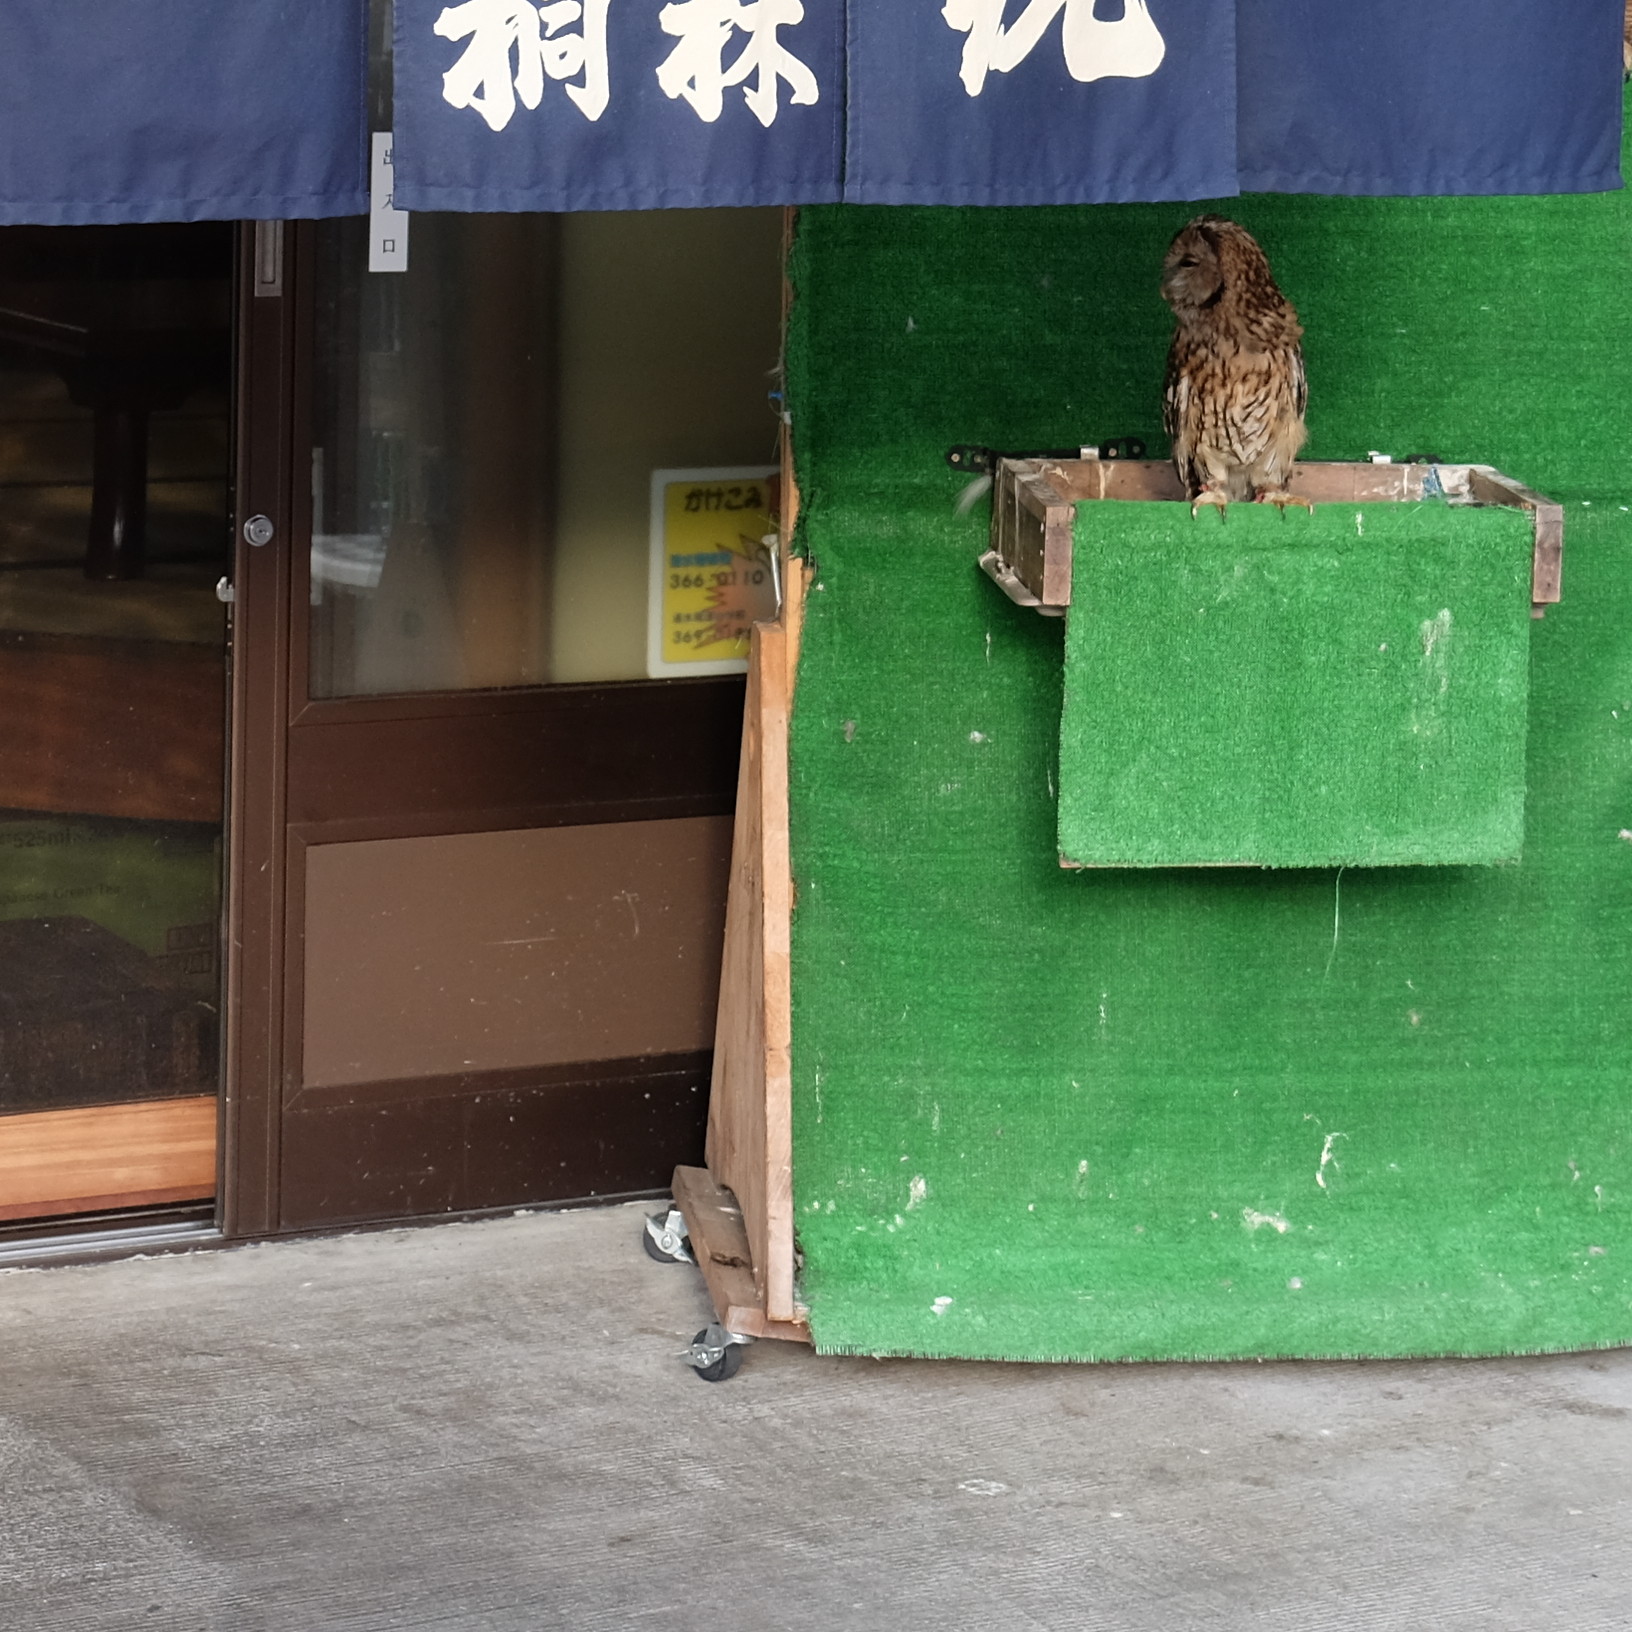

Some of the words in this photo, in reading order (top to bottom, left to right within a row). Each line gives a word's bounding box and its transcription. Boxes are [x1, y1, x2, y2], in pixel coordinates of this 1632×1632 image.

[684, 485, 763, 513] かけこみ
[53, 886, 94, 900] Green
